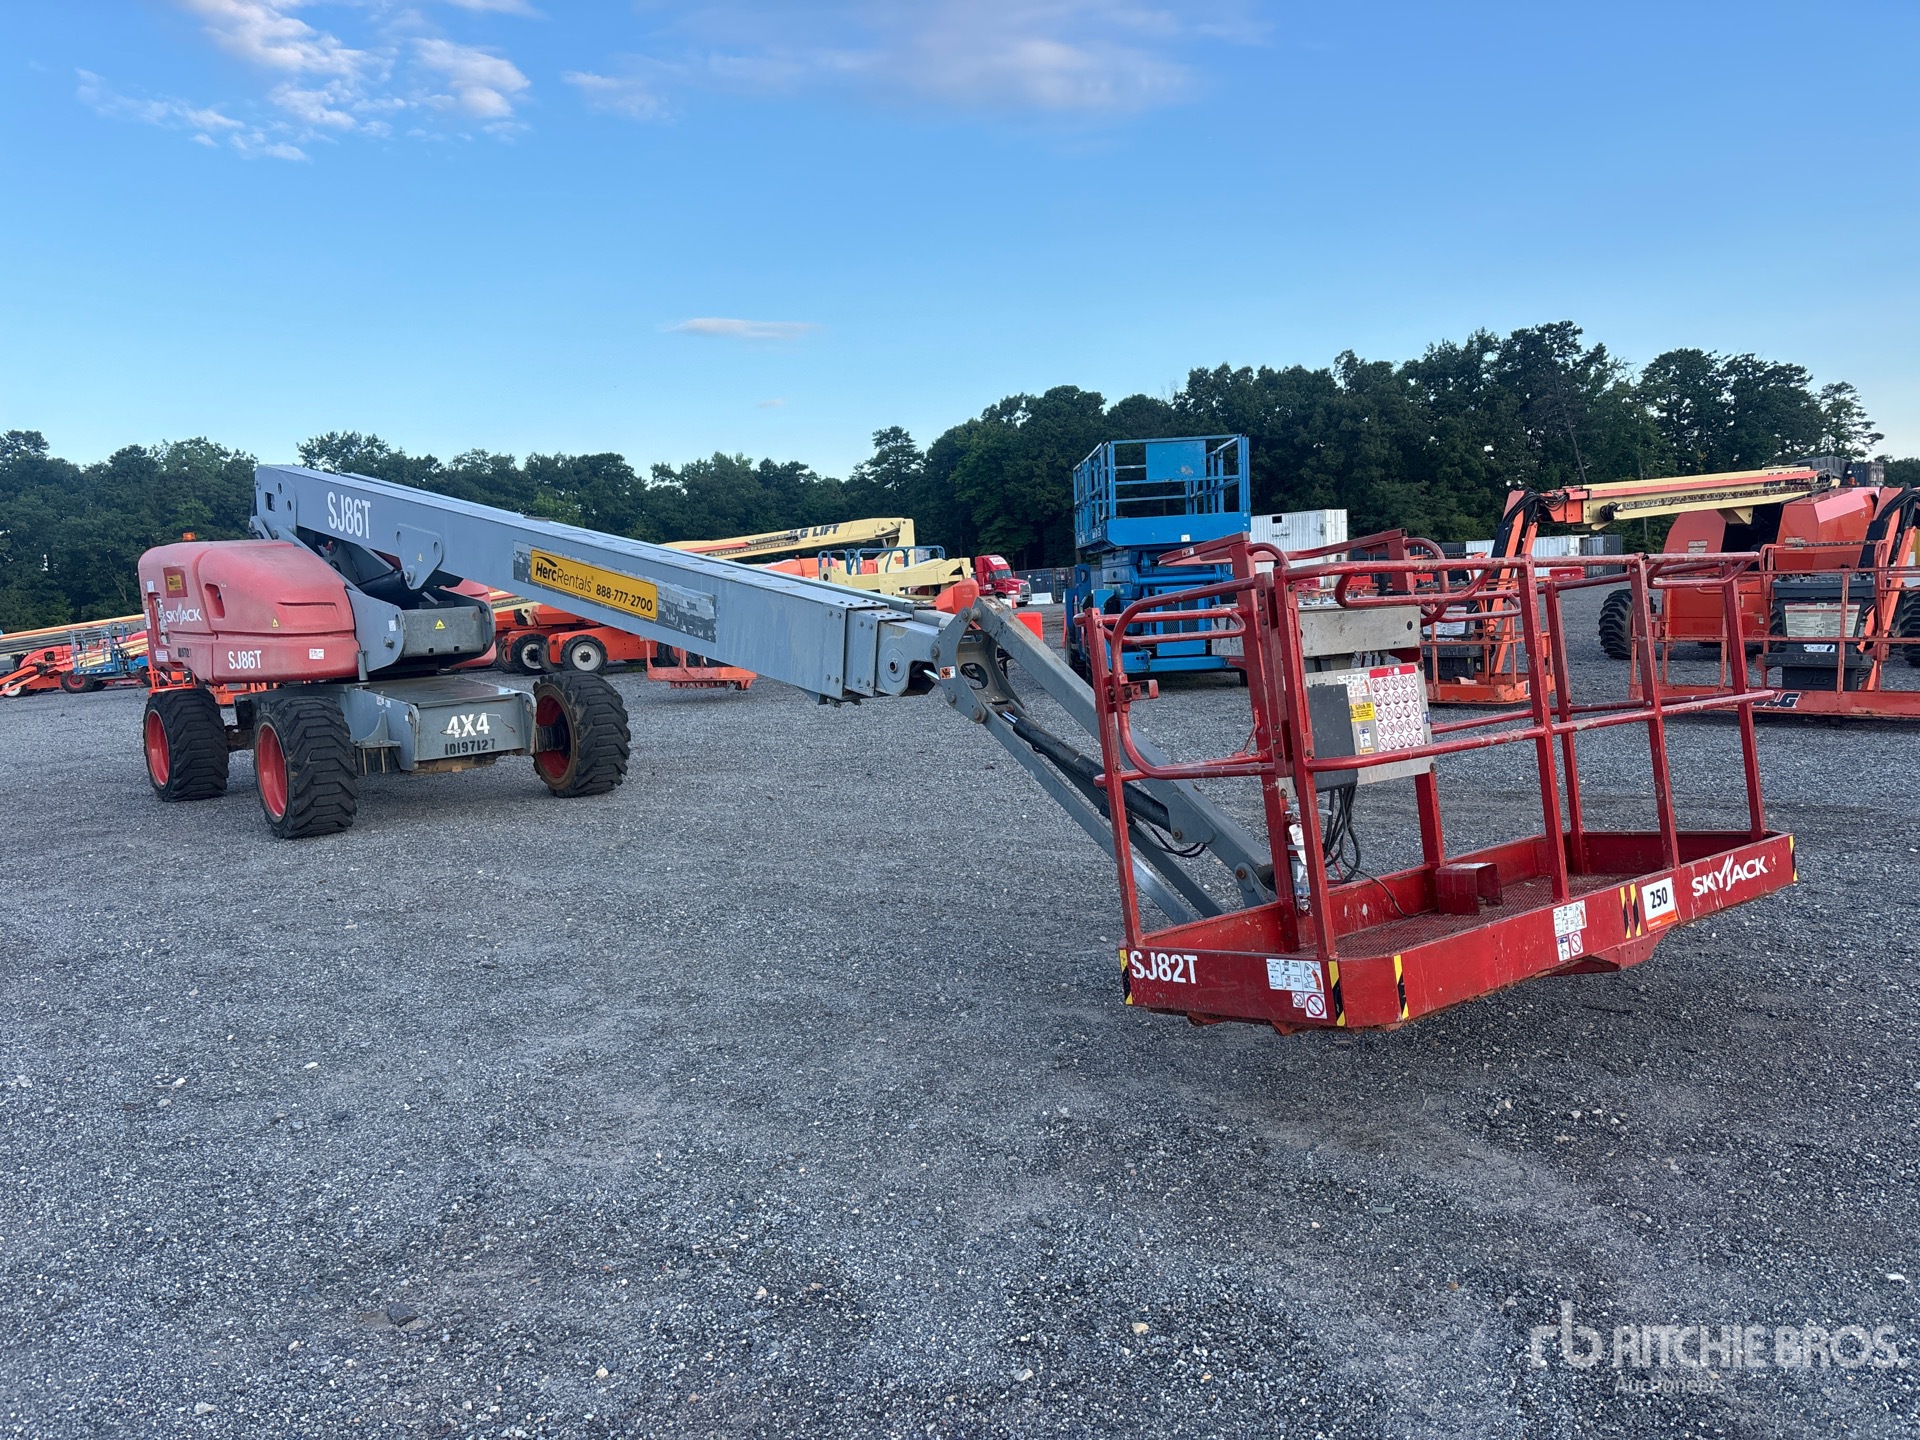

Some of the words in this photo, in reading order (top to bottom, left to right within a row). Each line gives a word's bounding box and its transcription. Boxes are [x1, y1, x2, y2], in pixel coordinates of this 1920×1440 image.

[327, 491, 371, 539] SJ86T
[812, 525, 839, 537] LIFT
[595, 584, 653, 612] 888-777-2700
[166, 602, 202, 625] SKYJACK
[228, 650, 262, 670] SJ86T
[446, 712, 491, 738] 4X4
[444, 738, 496, 755] 10197127
[1691, 854, 1769, 897] SKYJACK
[1649, 886, 1668, 909] 250
[1129, 950, 1198, 984] SJ82T
